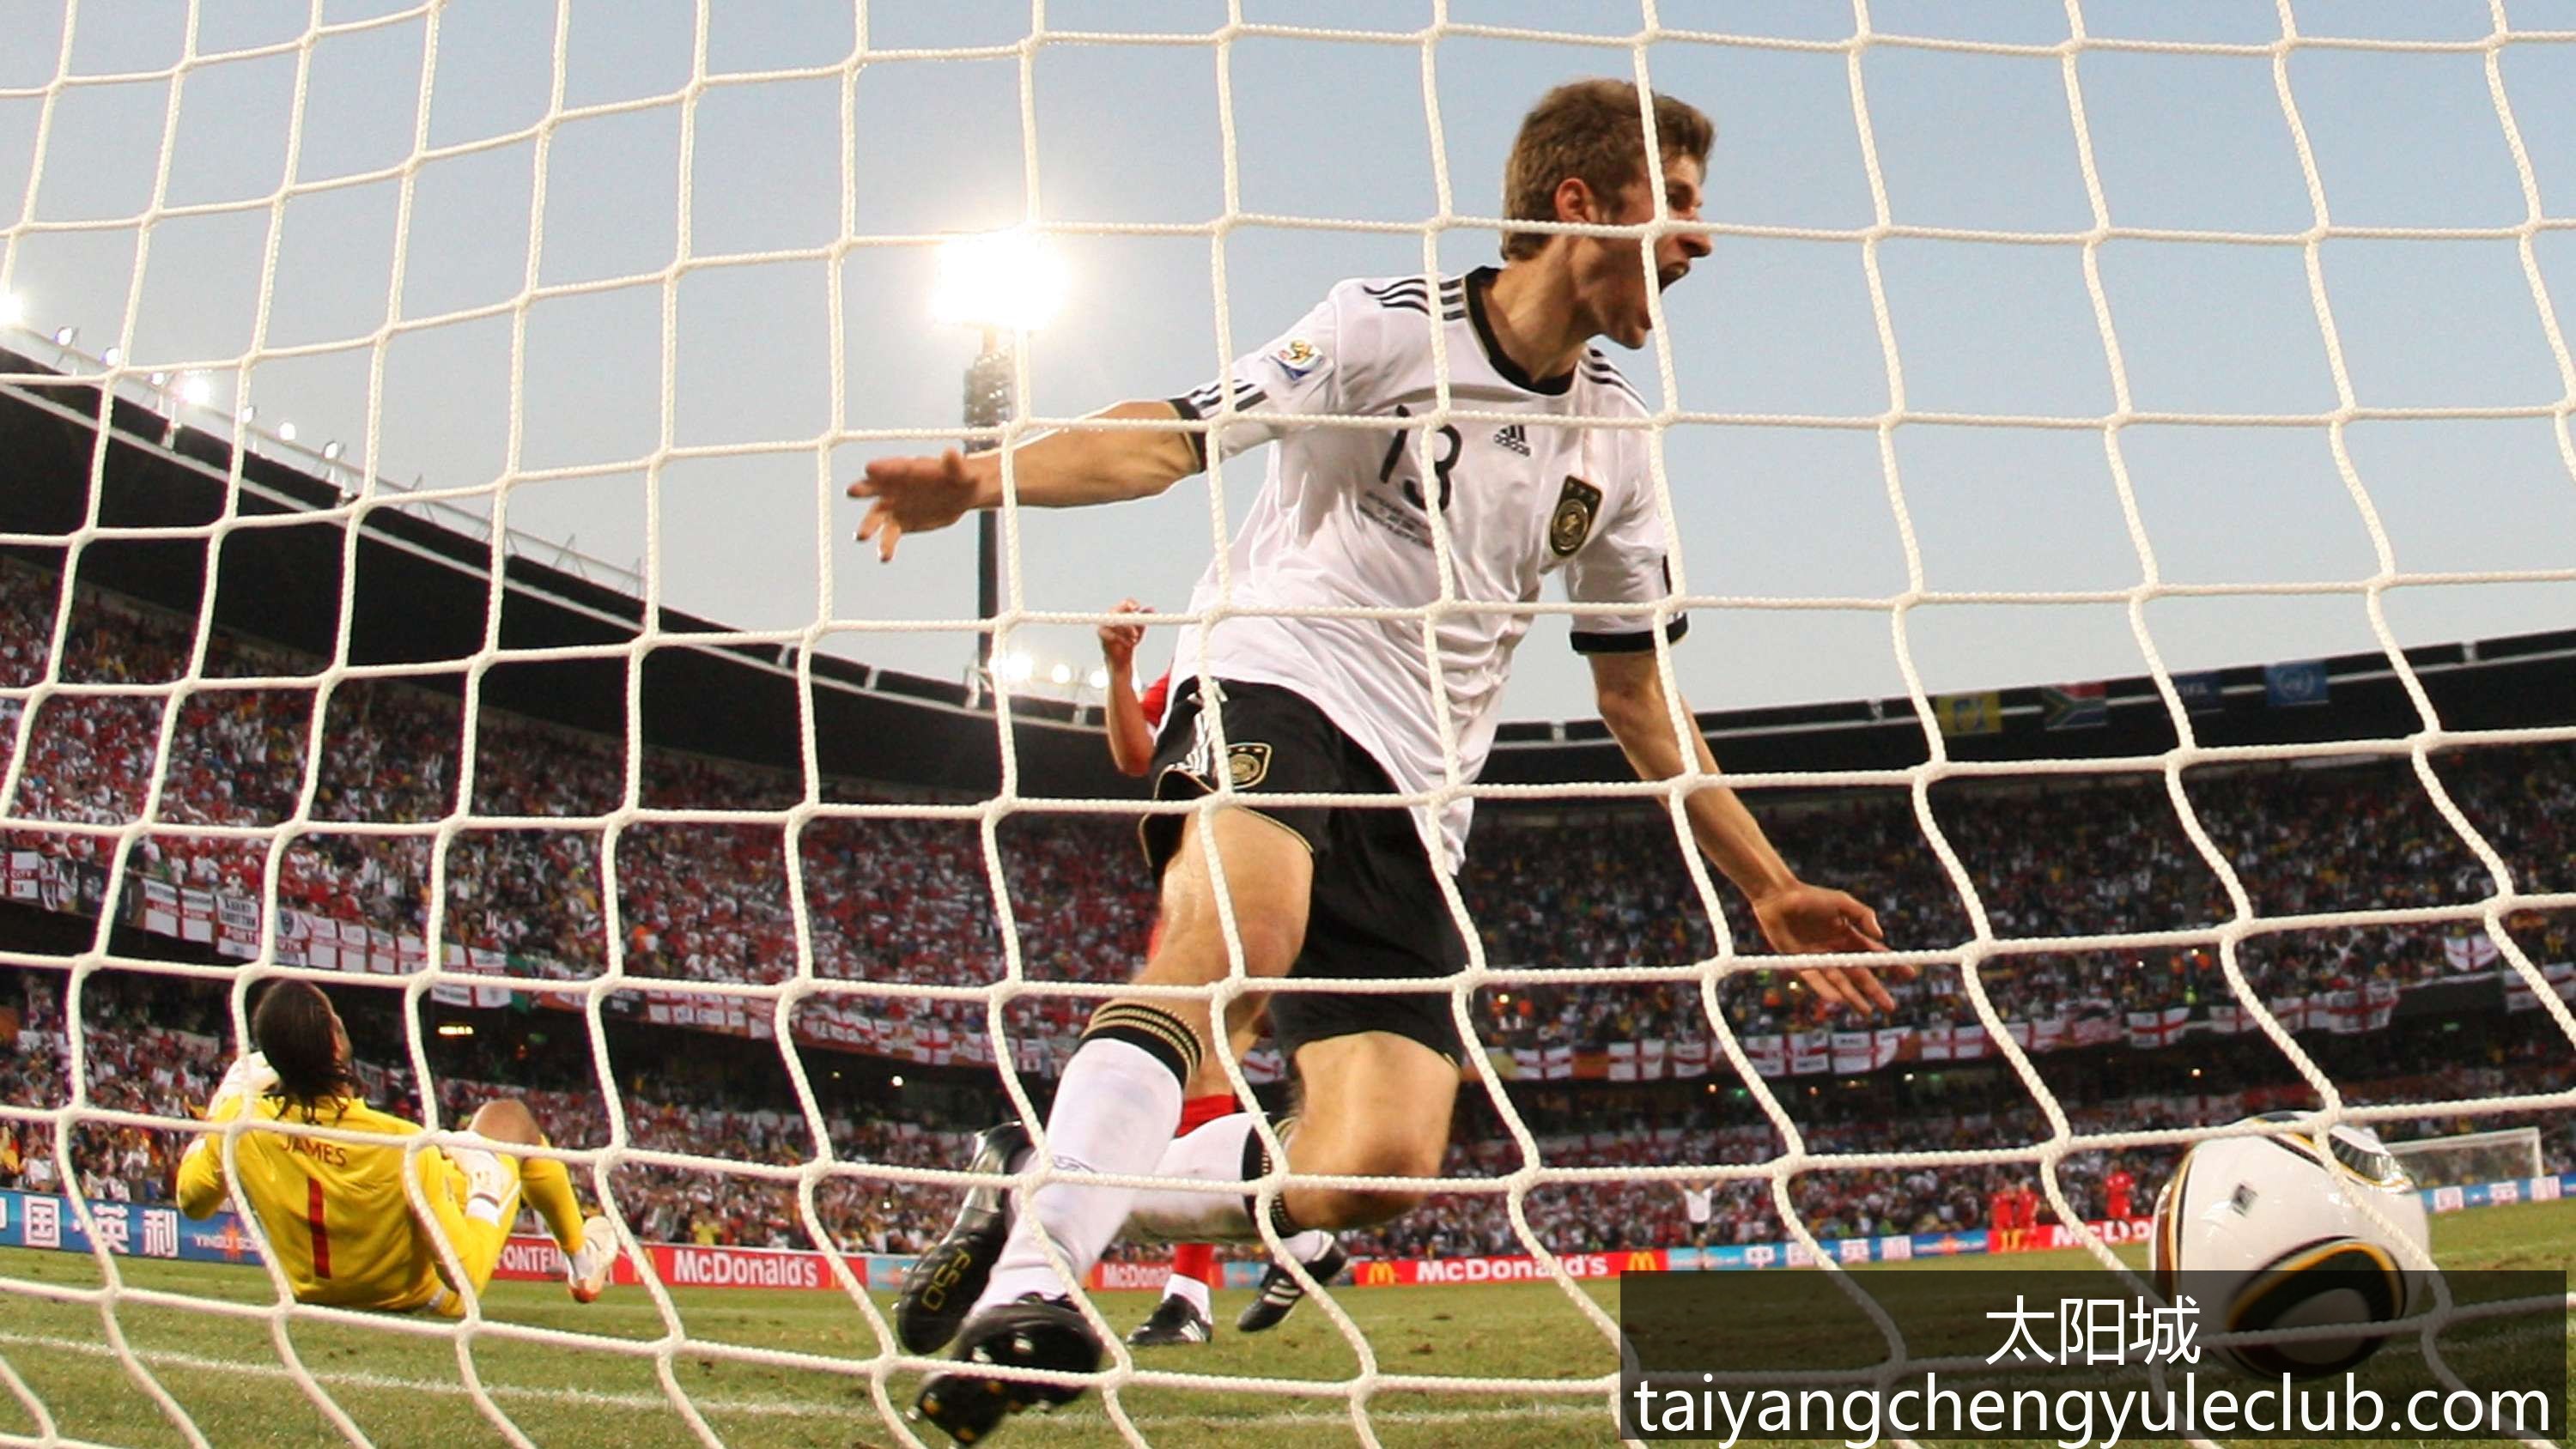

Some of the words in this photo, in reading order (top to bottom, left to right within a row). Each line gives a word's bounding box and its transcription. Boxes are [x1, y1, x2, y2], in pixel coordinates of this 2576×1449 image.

[282, 1132, 347, 1168] JAMES
[307, 1176, 332, 1280] 1
[673, 1249, 818, 1287] McDonald's
[1417, 1256, 1609, 1282] McDonald's
